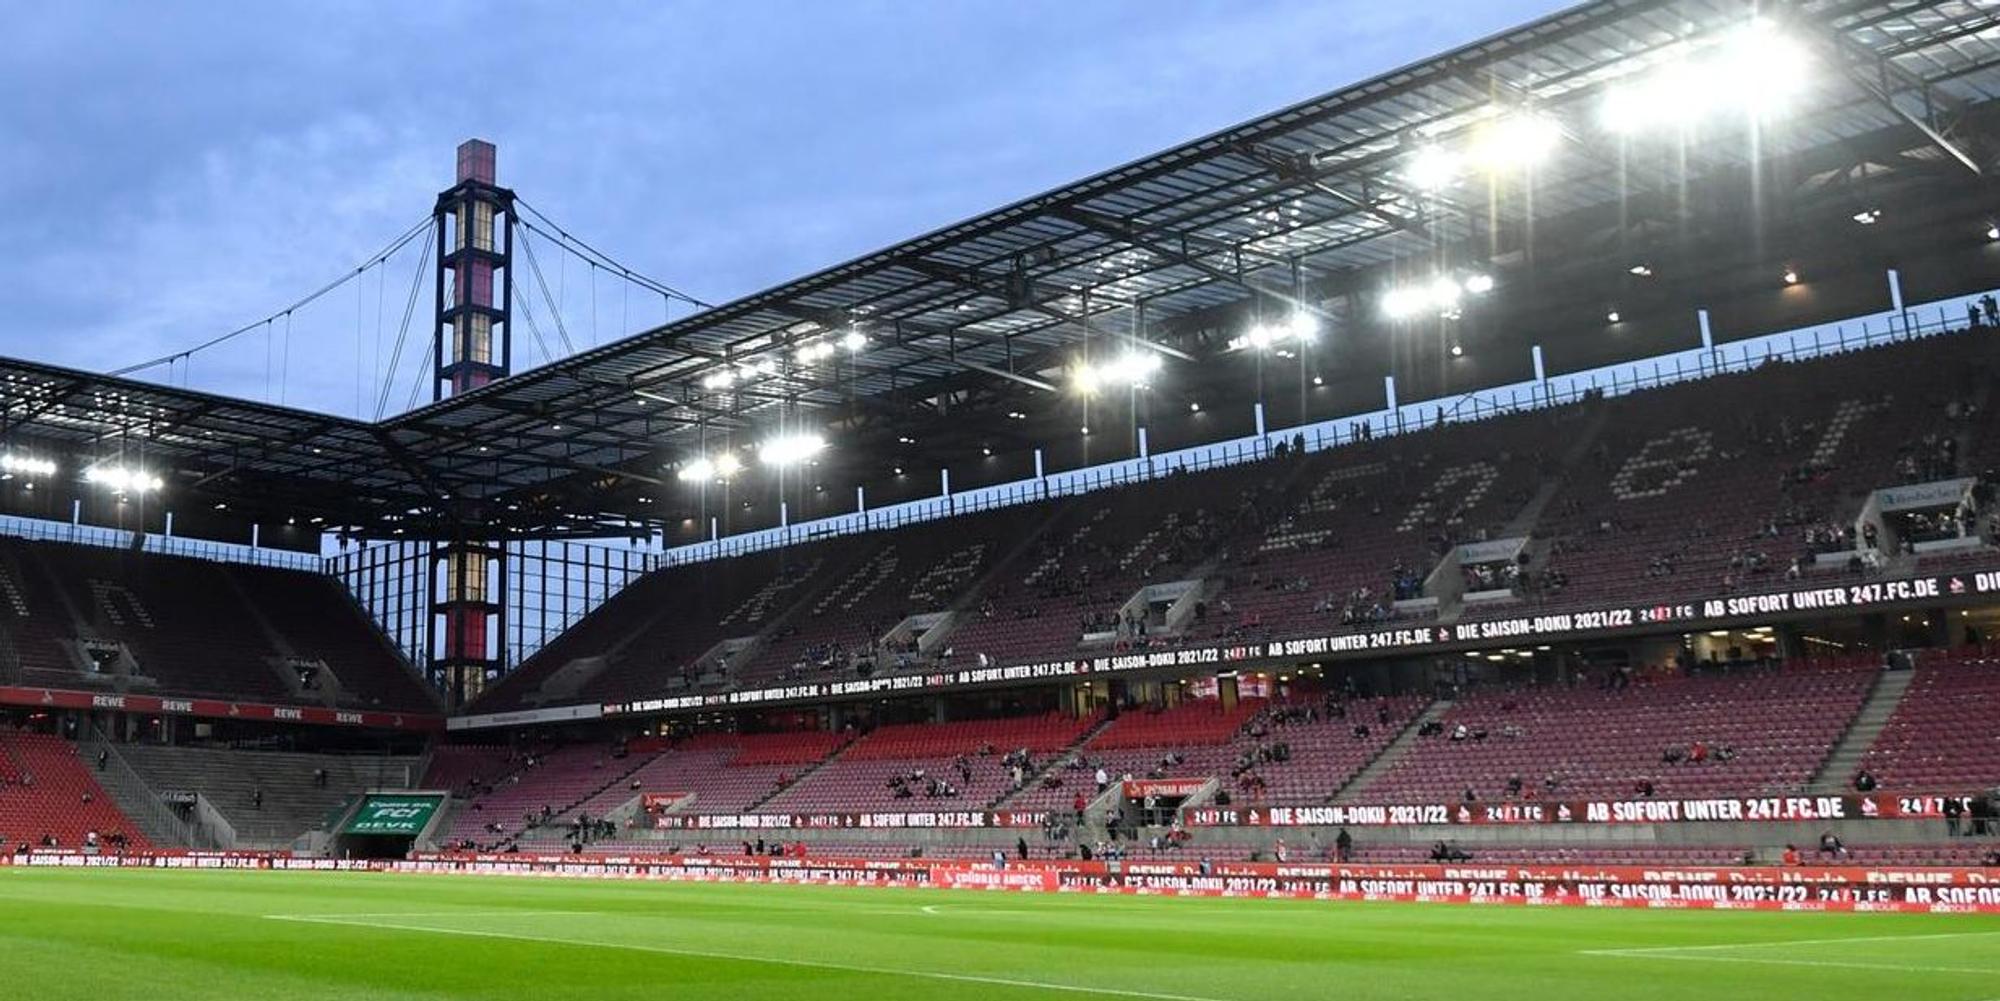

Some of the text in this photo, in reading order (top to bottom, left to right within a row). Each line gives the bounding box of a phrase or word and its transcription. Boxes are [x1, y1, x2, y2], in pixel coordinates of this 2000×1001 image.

[1704, 578, 1939, 618] AB SOFORT UNTER 247.FC.DE
[1676, 604, 1694, 619] FC
[1456, 608, 1633, 640] DIE SAISON-DOKU 2021/22
[1268, 628, 1432, 656] AB SOFORT UNTER 247.FC.DE
[1094, 647, 1219, 672] DIE SAISON-DOKU 2021/22
[959, 660, 1077, 683] AB SOFORT UNTER 247.FC.DE
[831, 683, 843, 695] DIE
[893, 675, 923, 689] 2021/22
[92, 696, 126, 708] REWE
[162, 700, 193, 712] REWE
[274, 708, 302, 720] REWE
[336, 712, 364, 724] REWE
[373, 808, 421, 818] FC!
[1270, 804, 1448, 825] DIE SAISON-DOKU 2021/22
[1486, 806, 1543, 820] 24/7 FC
[1586, 797, 1845, 821] AB SOFORT UNTER 247.FC.DE
[859, 812, 985, 827] AB SOFORT UNTER 247.FC.DE
[1194, 810, 1238, 824] 24/7 FC
[355, 822, 417, 830] DEVK
[1360, 881, 1414, 894] SOFORT
[1417, 882, 1464, 895] UNTER
